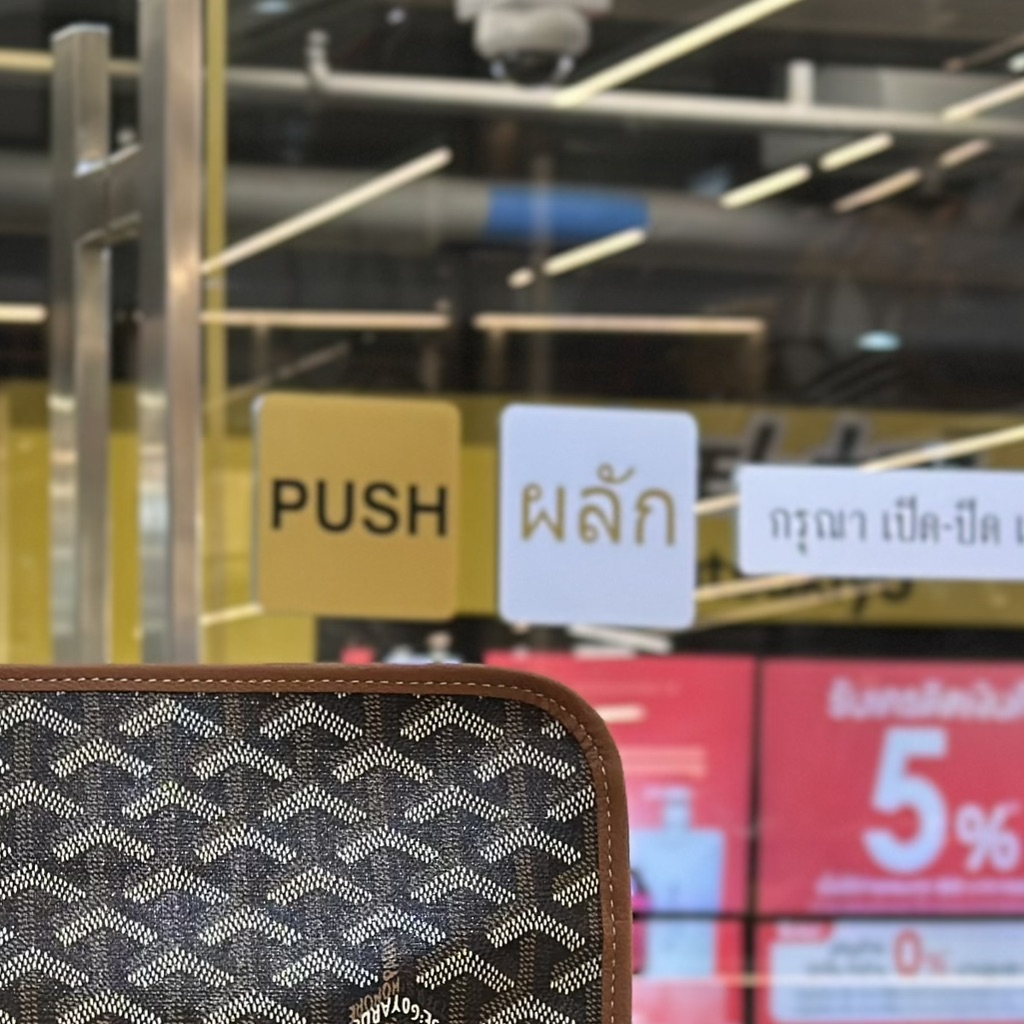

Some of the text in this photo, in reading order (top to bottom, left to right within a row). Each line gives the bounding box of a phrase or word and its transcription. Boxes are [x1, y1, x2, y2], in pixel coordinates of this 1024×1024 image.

[272, 478, 449, 537] PUSH
[522, 463, 675, 546] ผลัก
[770, 507, 867, 554] กรุณา
